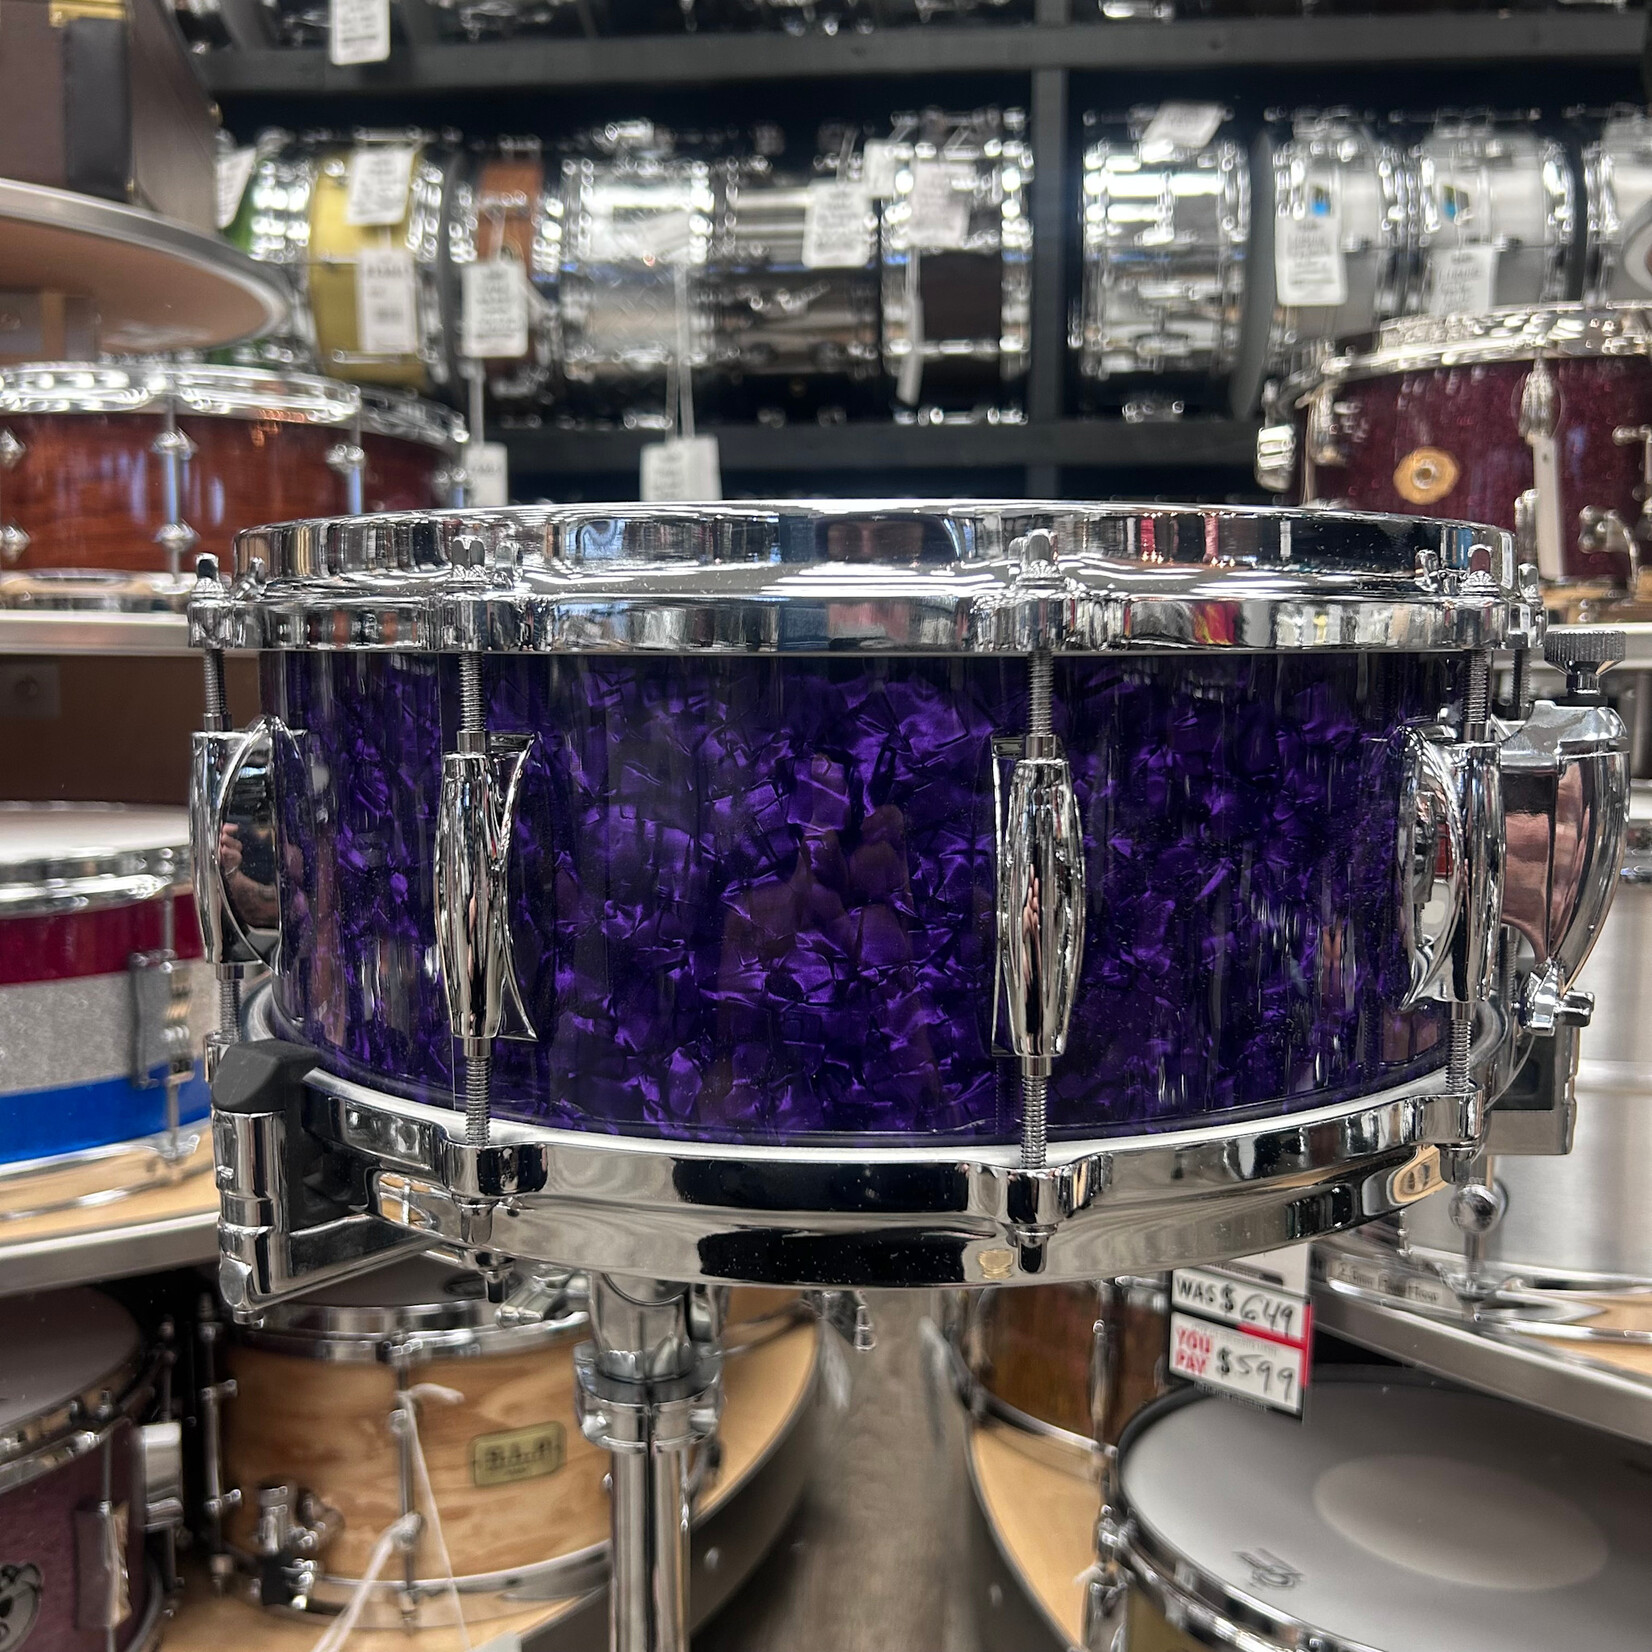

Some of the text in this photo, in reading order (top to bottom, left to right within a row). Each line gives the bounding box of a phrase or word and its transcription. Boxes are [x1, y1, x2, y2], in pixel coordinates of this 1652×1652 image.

[1176, 1276, 1294, 1339] WAS $649
[1176, 1325, 1211, 1353] YOU
[1175, 1350, 1208, 1376] PAY
[1216, 1347, 1296, 1403] $599
